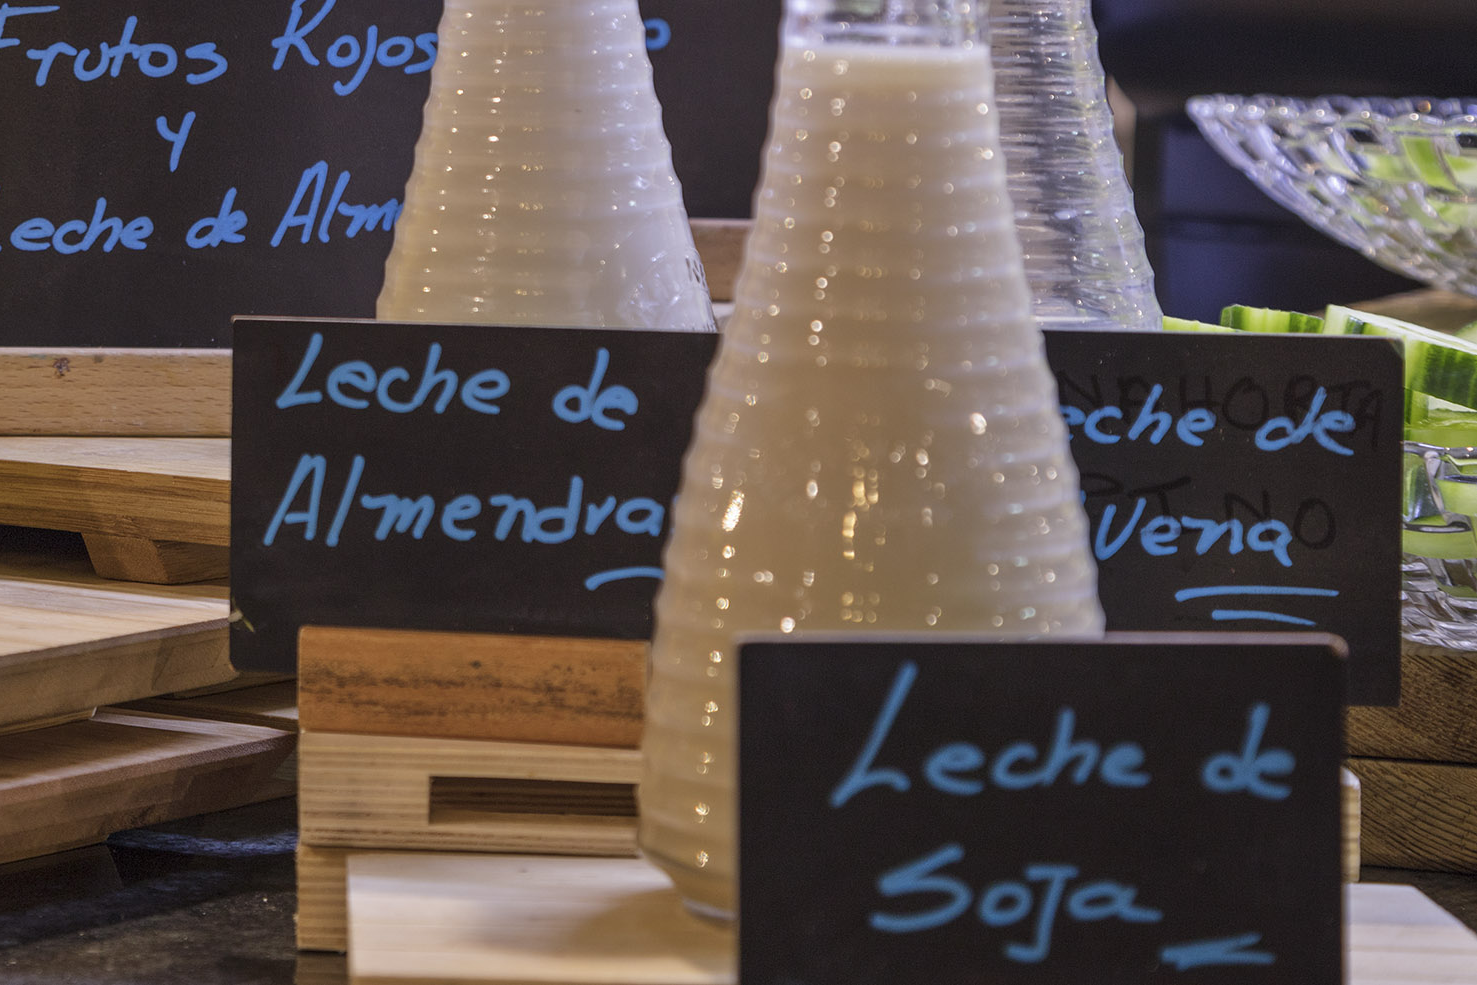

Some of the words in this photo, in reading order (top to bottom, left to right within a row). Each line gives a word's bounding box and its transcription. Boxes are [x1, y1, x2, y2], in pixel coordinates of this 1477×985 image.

[185, 186, 248, 249] de
[269, 159, 405, 248] Alm
[276, 332, 511, 415] Leche
[552, 348, 639, 431] de
[1060, 383, 1217, 447] eche
[1254, 386, 1356, 456] de
[263, 454, 679, 547] Almendra
[832, 662, 1150, 807] Leche
[1202, 703, 1295, 800] de
